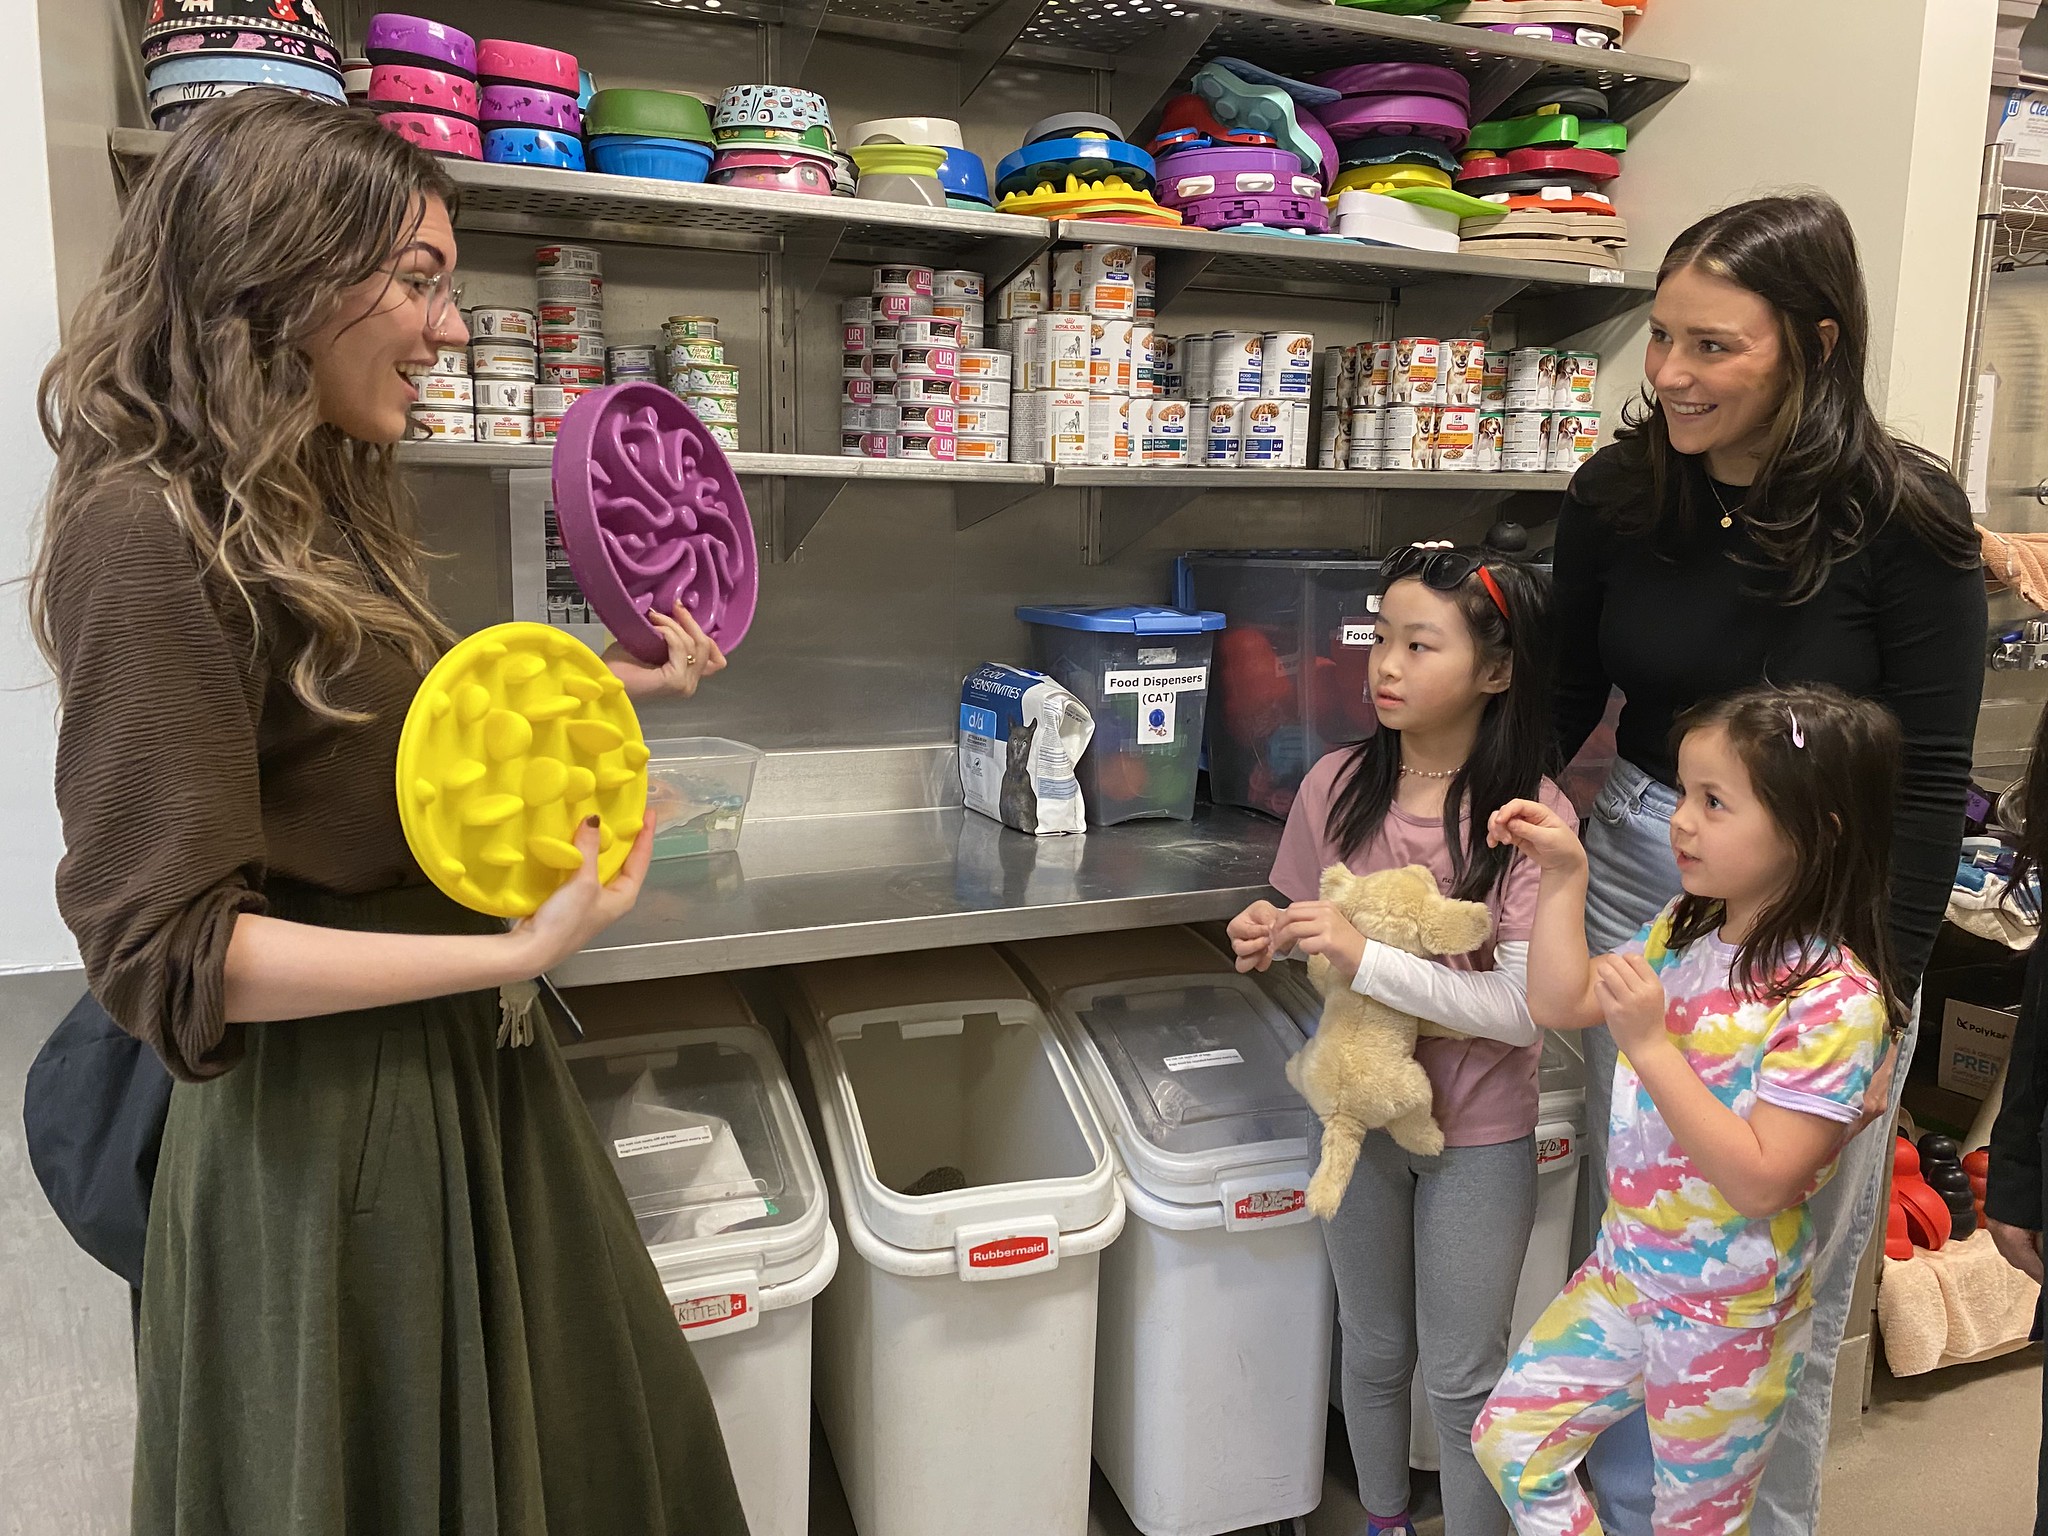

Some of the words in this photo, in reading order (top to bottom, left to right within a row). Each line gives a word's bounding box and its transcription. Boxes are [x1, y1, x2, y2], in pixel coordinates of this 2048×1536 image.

[919, 272, 930, 284] UR
[890, 297, 906, 310] UR
[848, 328, 860, 340] UR
[939, 351, 953, 365] UR
[856, 381, 871, 394] UR
[937, 408, 952, 422] UR
[873, 436, 884, 449] UR
[940, 438, 953, 451] UR
[980, 668, 1006, 680] FOOD
[1110, 678, 1139, 687] Food
[1143, 674, 1203, 687] Dispensers
[971, 678, 1022, 700] SENSITIVITIES
[1142, 692, 1175, 705] (CAT)
[968, 711, 984, 730] d/d
[973, 1243, 1044, 1261] Rubbermaid
[678, 1300, 727, 1322] KITTEN
